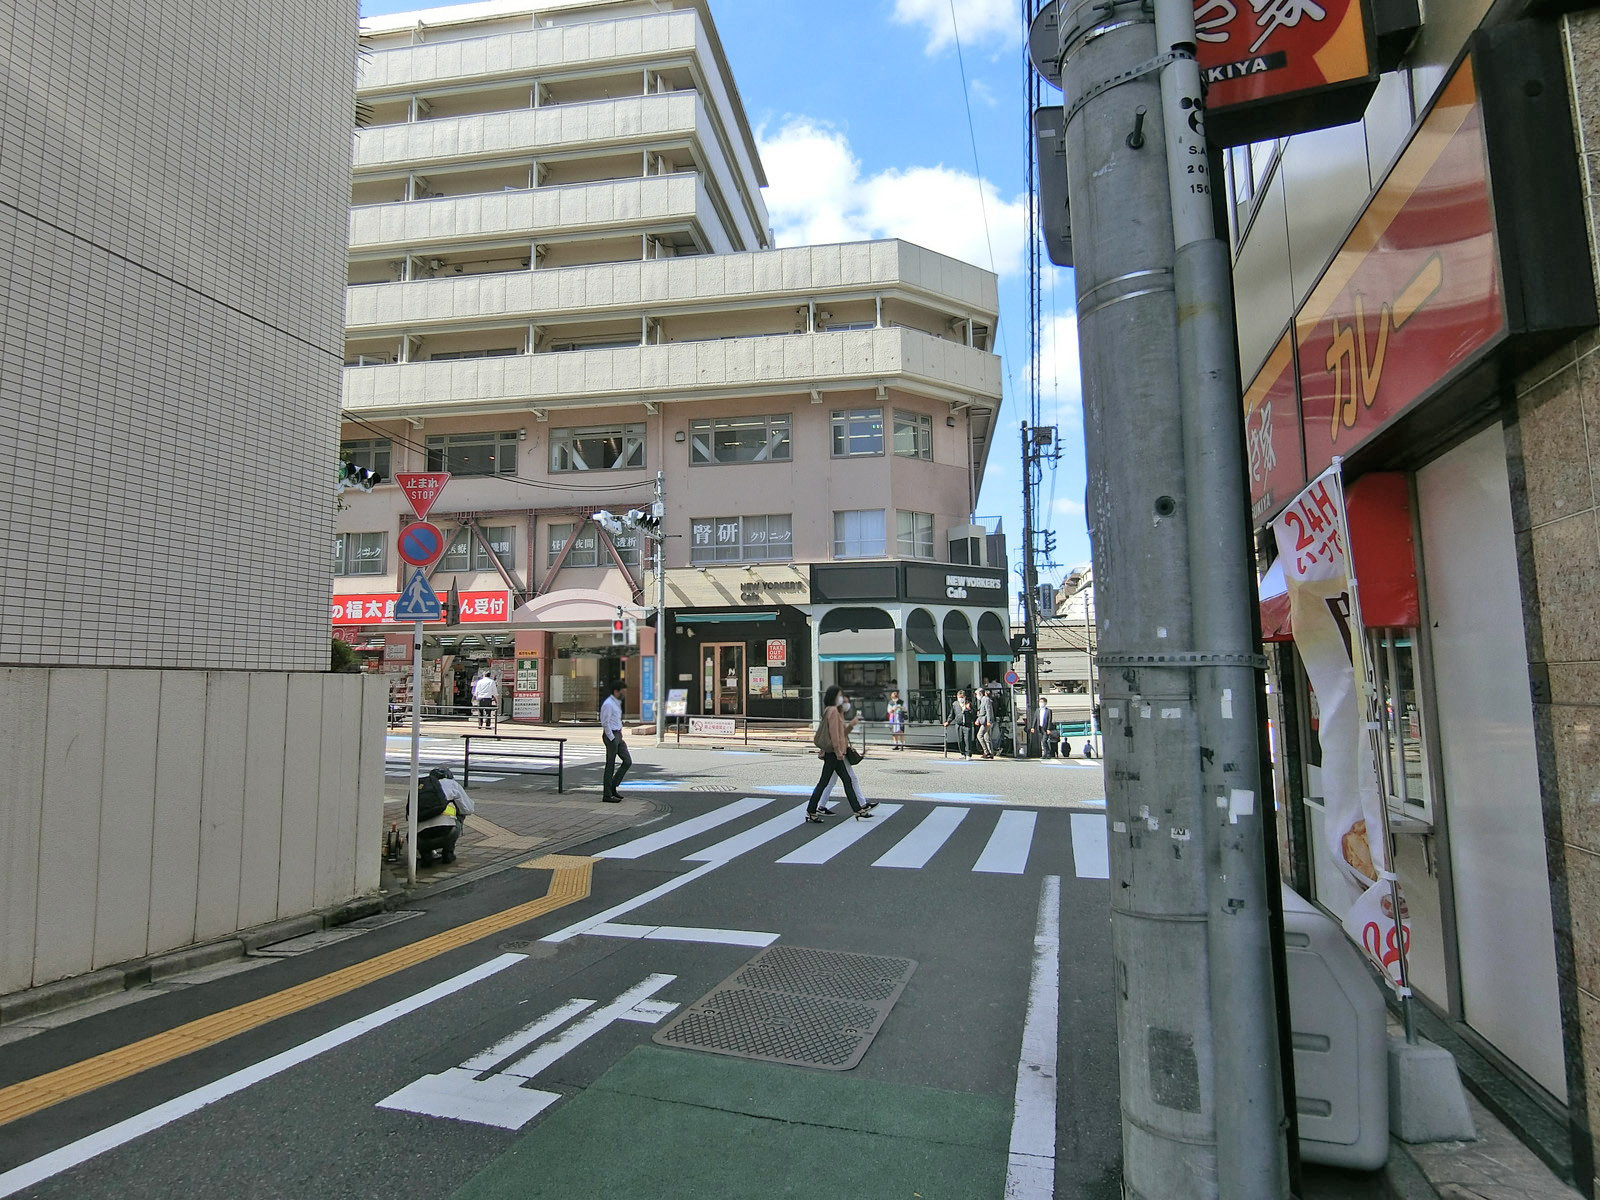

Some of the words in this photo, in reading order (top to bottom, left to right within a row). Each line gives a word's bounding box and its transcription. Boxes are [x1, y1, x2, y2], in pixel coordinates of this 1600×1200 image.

[1326, 251, 1443, 443] カレー
[406, 477, 439, 489] 止まれ
[411, 490, 434, 500] STOP
[1284, 480, 1338, 552] 24H
[693, 522, 739, 545] 腎研
[750, 530, 792, 543] クリニック
[616, 536, 637, 548] 透析
[740, 582, 760, 591] NEW
[762, 580, 803, 591] YORKER'S
[946, 575, 965, 587] NEW
[965, 576, 1002, 590] YORKER'S
[946, 587, 968, 599] Cafe
